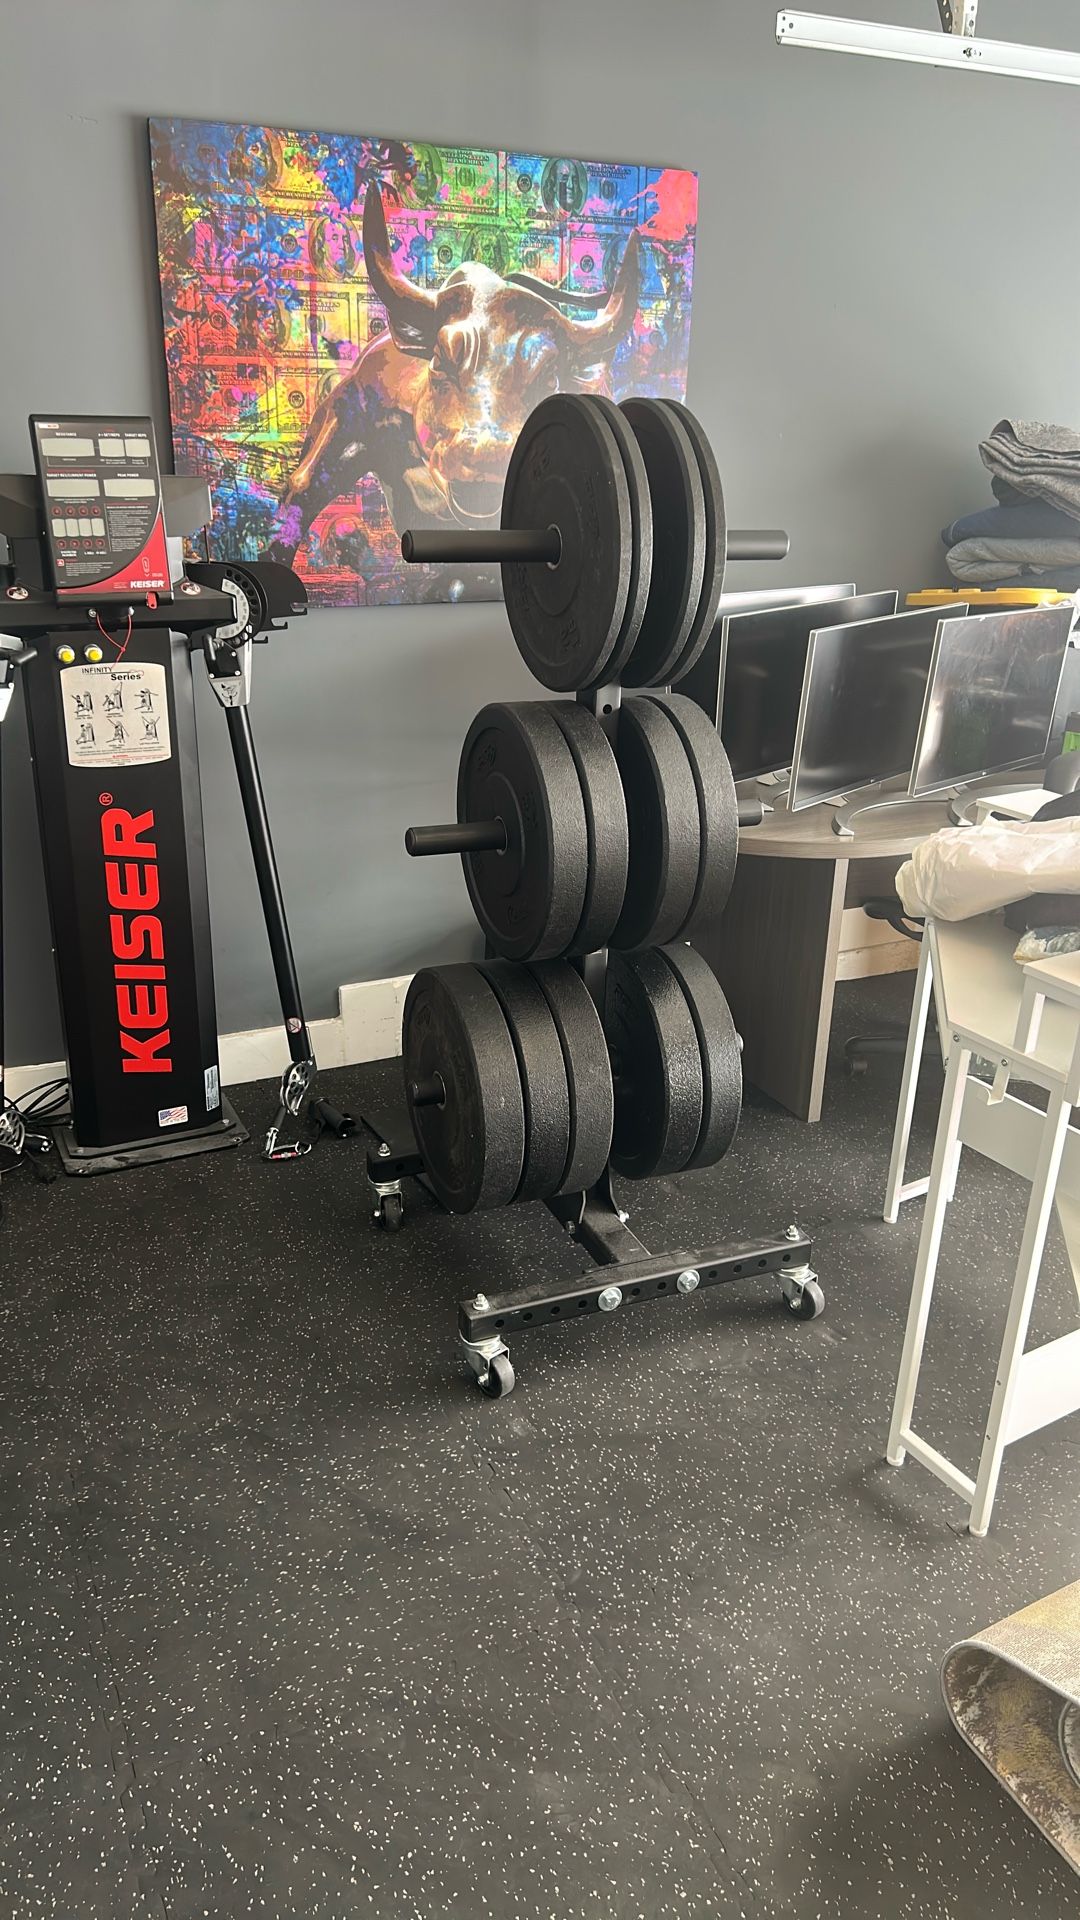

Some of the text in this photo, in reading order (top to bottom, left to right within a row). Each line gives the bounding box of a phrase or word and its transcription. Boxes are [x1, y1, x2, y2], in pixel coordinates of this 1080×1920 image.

[130, 580, 164, 589] KEISER
[81, 666, 112, 674] INFINITY
[110, 673, 142, 681] Series
[101, 808, 172, 1073] KEISER
